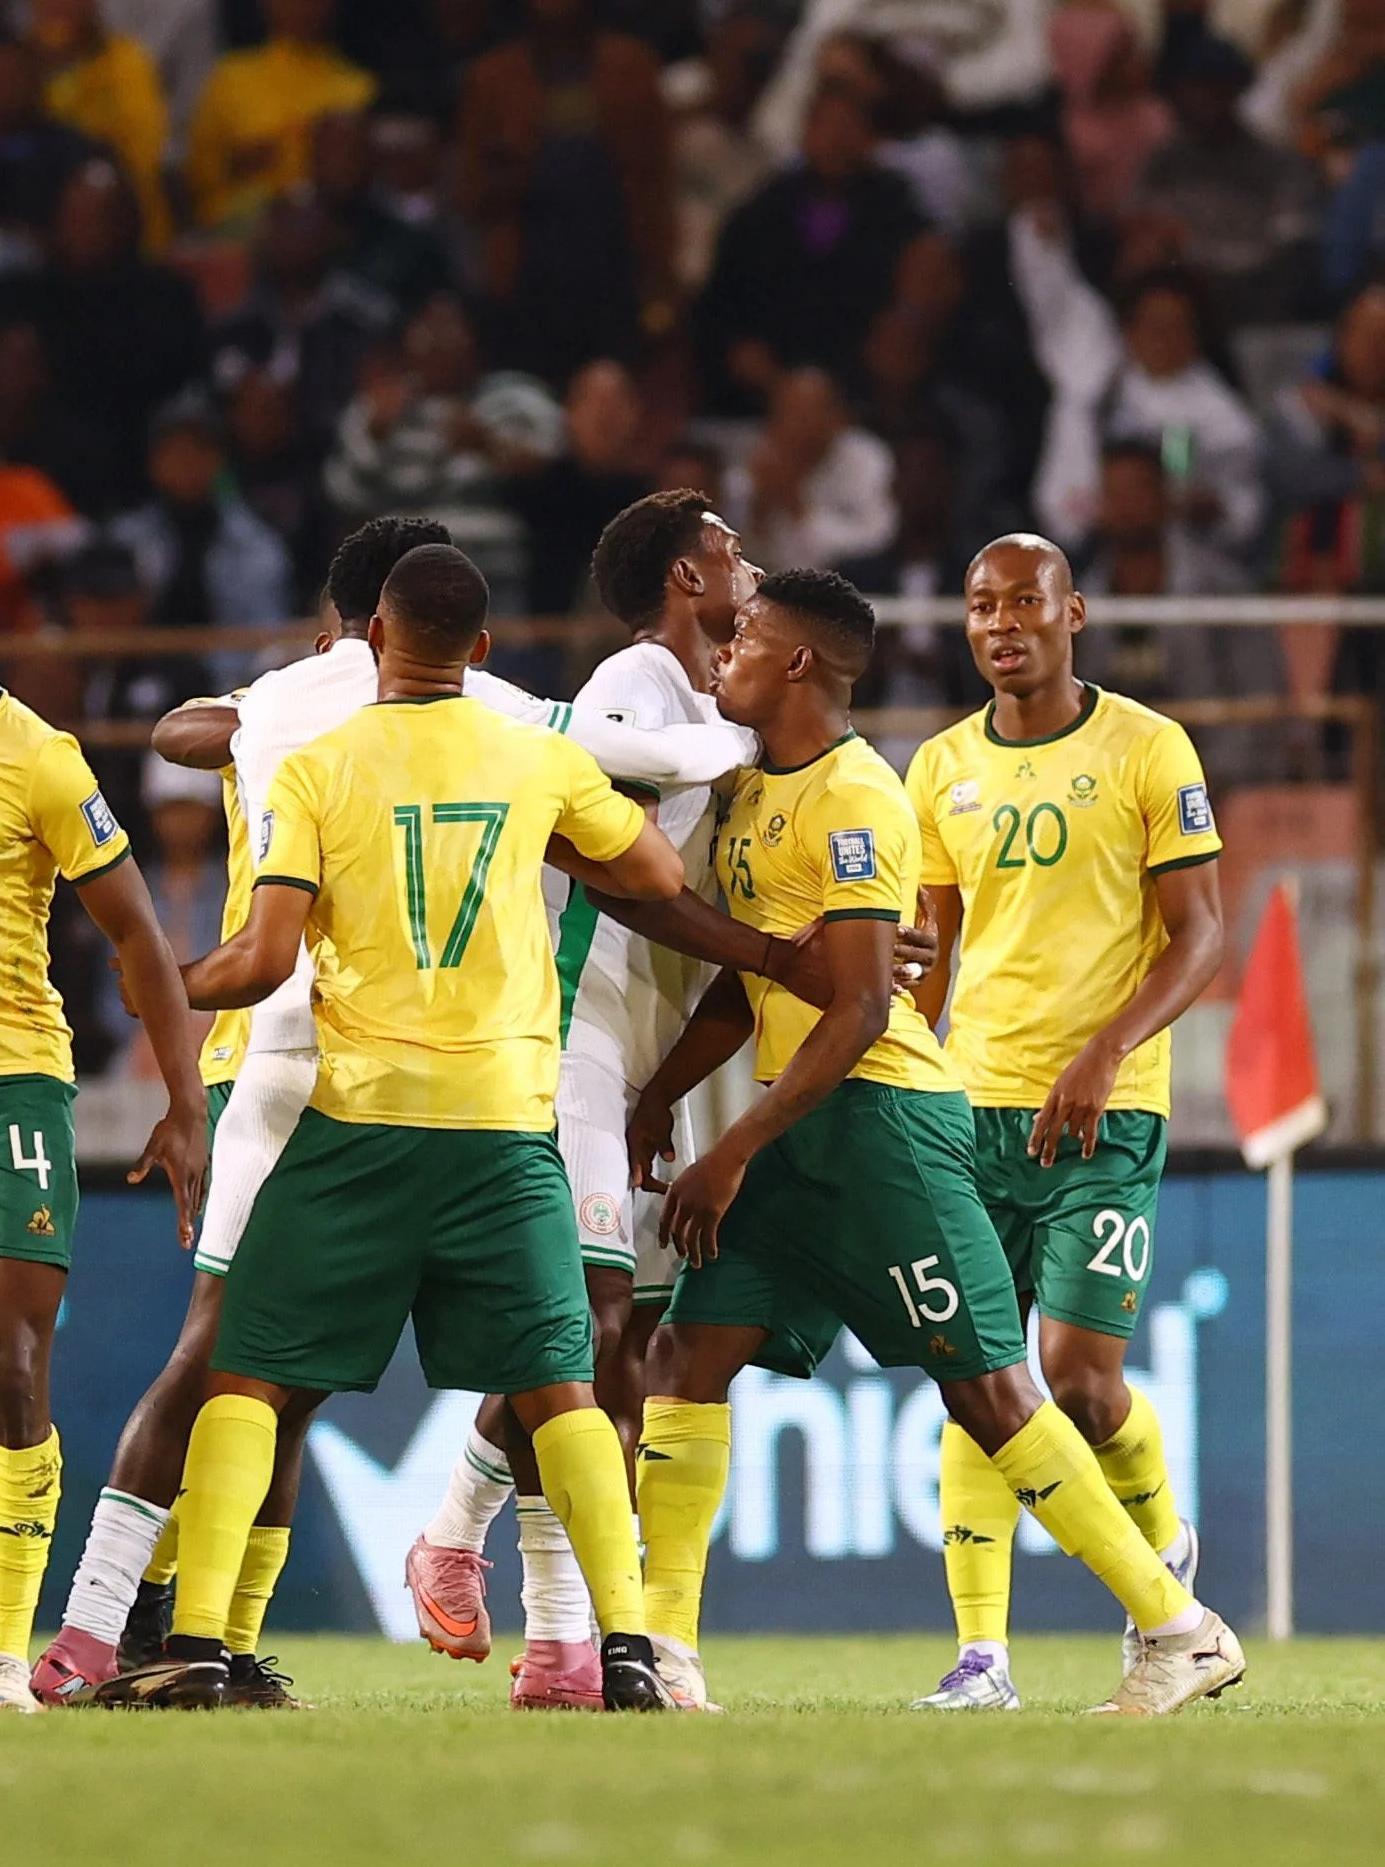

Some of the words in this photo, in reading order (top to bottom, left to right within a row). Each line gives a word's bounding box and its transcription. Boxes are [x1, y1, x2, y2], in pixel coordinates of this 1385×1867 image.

[727, 836, 756, 900] 15
[992, 802, 1068, 868] 20
[394, 802, 511, 971] 17
[9, 1124, 52, 1190] 4
[1086, 1209, 1150, 1282] 20
[887, 1254, 959, 1328] 15
